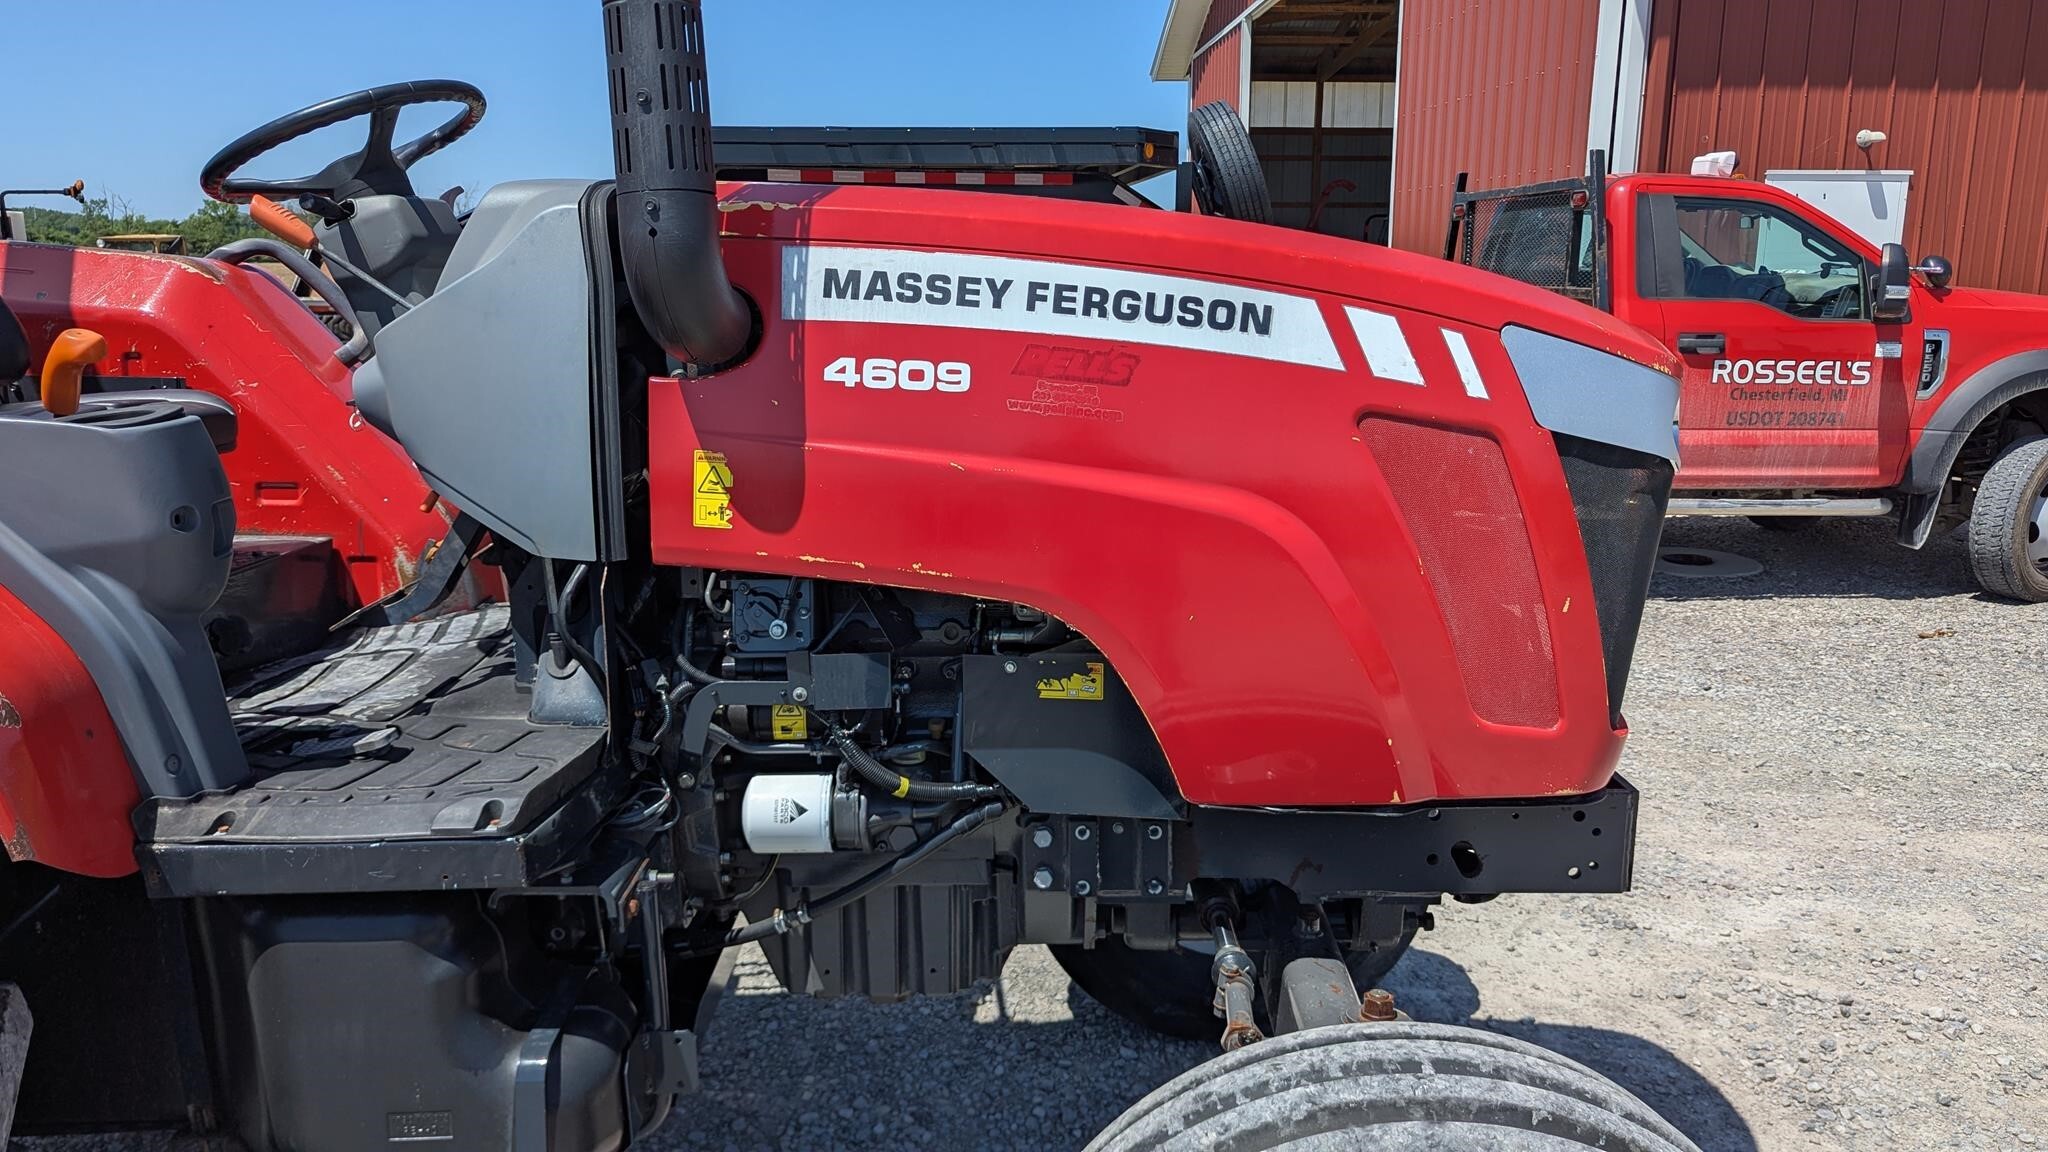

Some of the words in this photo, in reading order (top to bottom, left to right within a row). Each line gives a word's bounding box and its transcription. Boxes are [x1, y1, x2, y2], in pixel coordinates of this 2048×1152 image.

[822, 268, 1013, 310] MASSEY
[1026, 281, 1273, 334] FERGUSON
[823, 357, 971, 393] 4609
[1711, 359, 1873, 386] ROSSEEL'S
[1729, 387, 1826, 403] Chesterfield,
[1829, 388, 1849, 402] MI
[1726, 411, 1784, 427] USDOT
